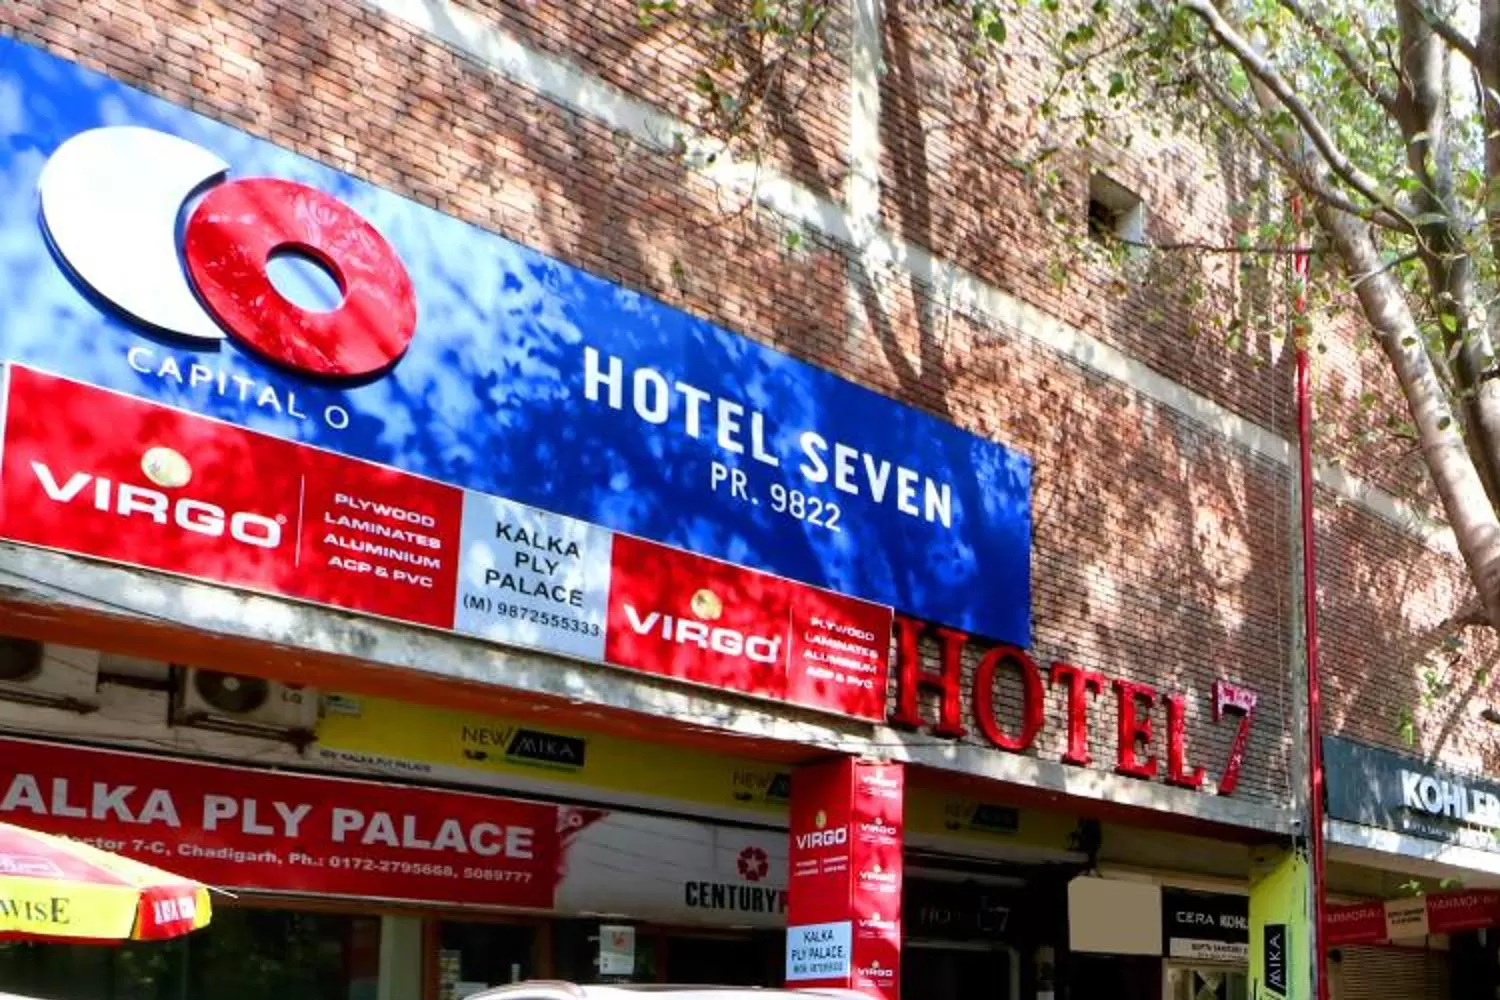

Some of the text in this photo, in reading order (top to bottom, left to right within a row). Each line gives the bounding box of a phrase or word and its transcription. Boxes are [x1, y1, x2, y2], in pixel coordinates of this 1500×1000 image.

[128, 347, 349, 429] CAPITAL O
[584, 346, 951, 529] HOTEL SEVEN
[31, 460, 282, 548] VIRGO
[335, 493, 435, 528] PLYWOOD
[711, 461, 841, 532] PR. 9822
[324, 511, 440, 549] LAMINATES
[495, 521, 580, 559] KALKA
[323, 533, 441, 569] ALUMINIUM
[515, 552, 559, 577] PLY
[328, 556, 433, 588] ACP & PVC
[485, 569, 584, 607] PALACE
[463, 593, 600, 637] (M) 9872555333
[623, 604, 779, 664] VIRGO
[886, 615, 1258, 795] HOTEL 7
[462, 726, 508, 748] NEW
[203, 794, 313, 836] PLY
[331, 807, 535, 860] PALACE
[796, 828, 848, 850] VIRGO
[178, 842, 283, 867] Chadigarh,
[1175, 911, 1214, 925] CERA
